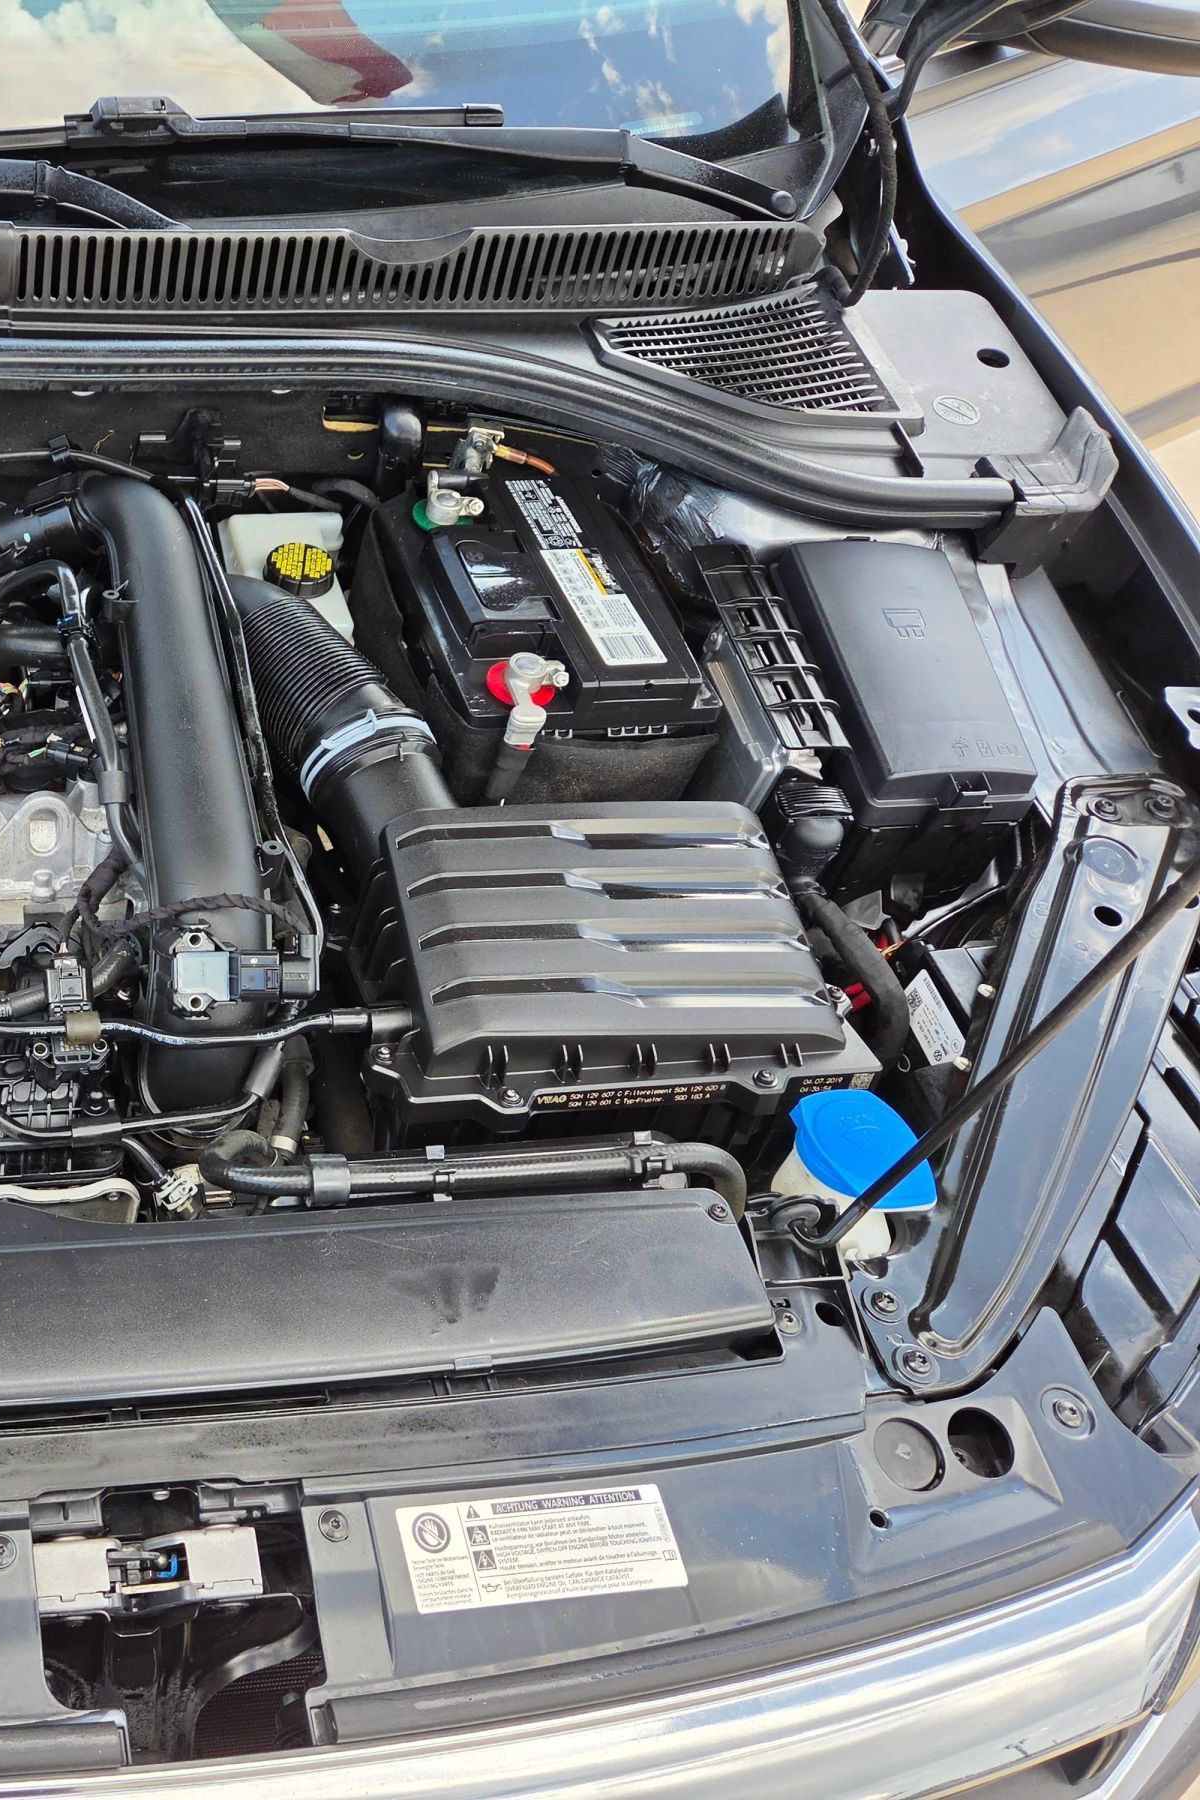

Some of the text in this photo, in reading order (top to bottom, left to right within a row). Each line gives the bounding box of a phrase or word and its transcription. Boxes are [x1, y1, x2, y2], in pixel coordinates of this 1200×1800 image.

[494, 1491, 636, 1513] ACHTUNG WARNING ATTENTION
[610, 1523, 623, 1531] tout
